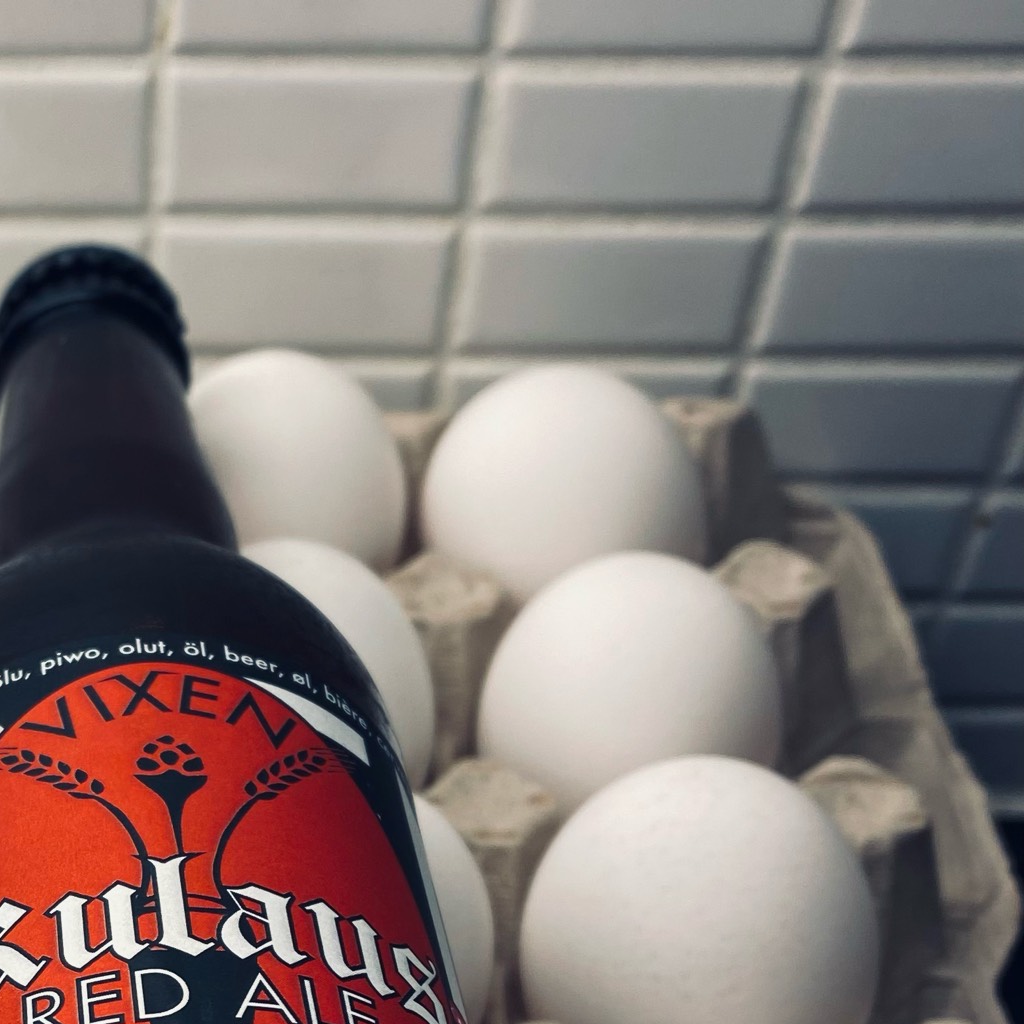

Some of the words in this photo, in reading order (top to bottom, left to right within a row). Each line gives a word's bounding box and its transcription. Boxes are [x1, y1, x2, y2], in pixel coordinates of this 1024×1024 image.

[19, 669, 297, 750] VIXEN
[39, 644, 108, 676] piwo,
[118, 638, 174, 659] olut,
[183, 640, 214, 661] öl,
[224, 642, 285, 679] beer,
[292, 672, 318, 694] øl,
[323, 683, 372, 737] bière,
